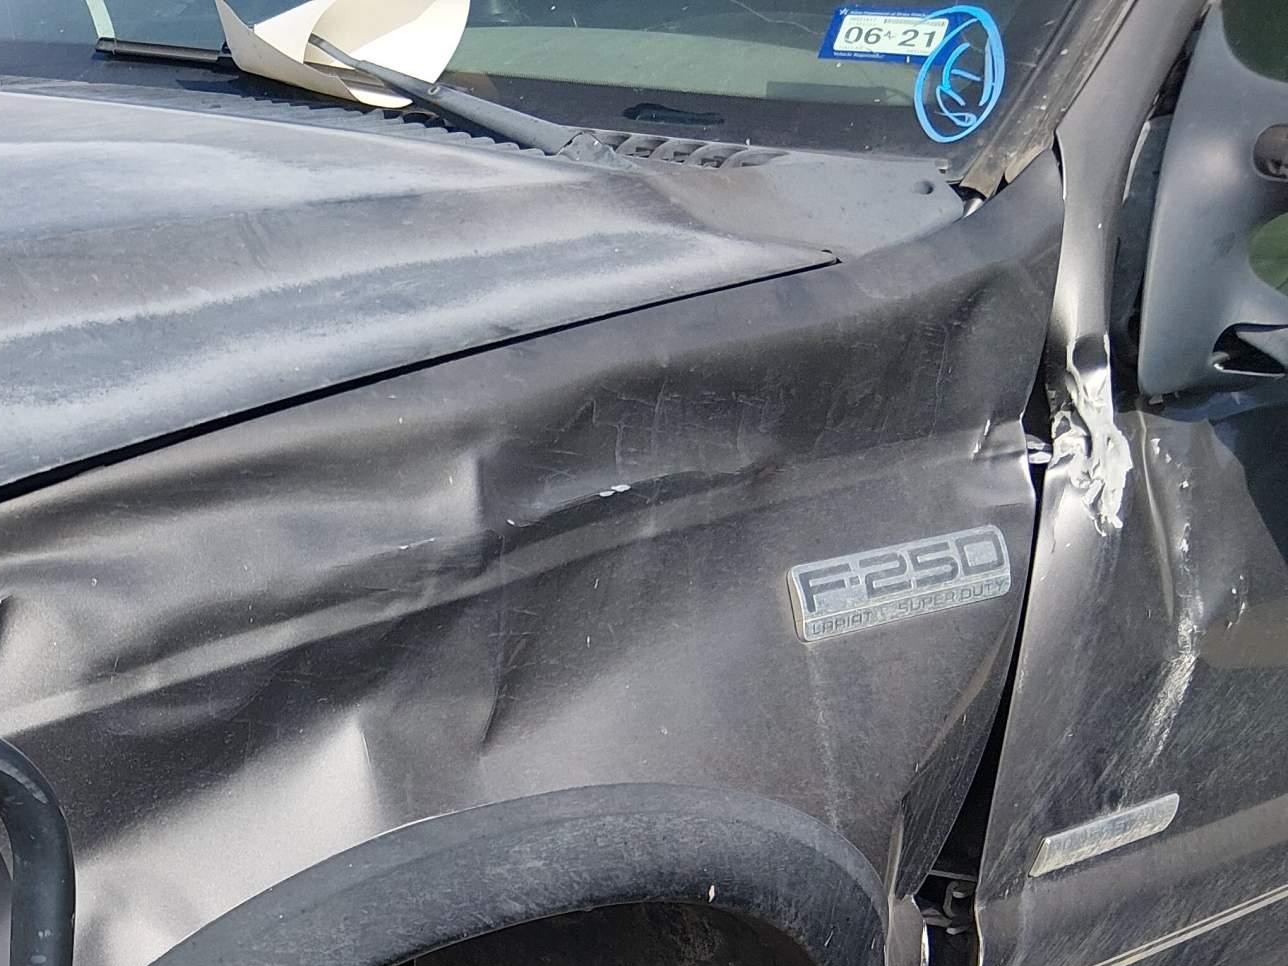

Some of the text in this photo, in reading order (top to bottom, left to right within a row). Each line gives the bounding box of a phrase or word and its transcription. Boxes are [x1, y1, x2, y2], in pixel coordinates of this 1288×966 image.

[844, 26, 938, 48] 06 21
[798, 531, 1005, 612] F-250
[812, 578, 1006, 636] LARIAT SUPER DUTY
